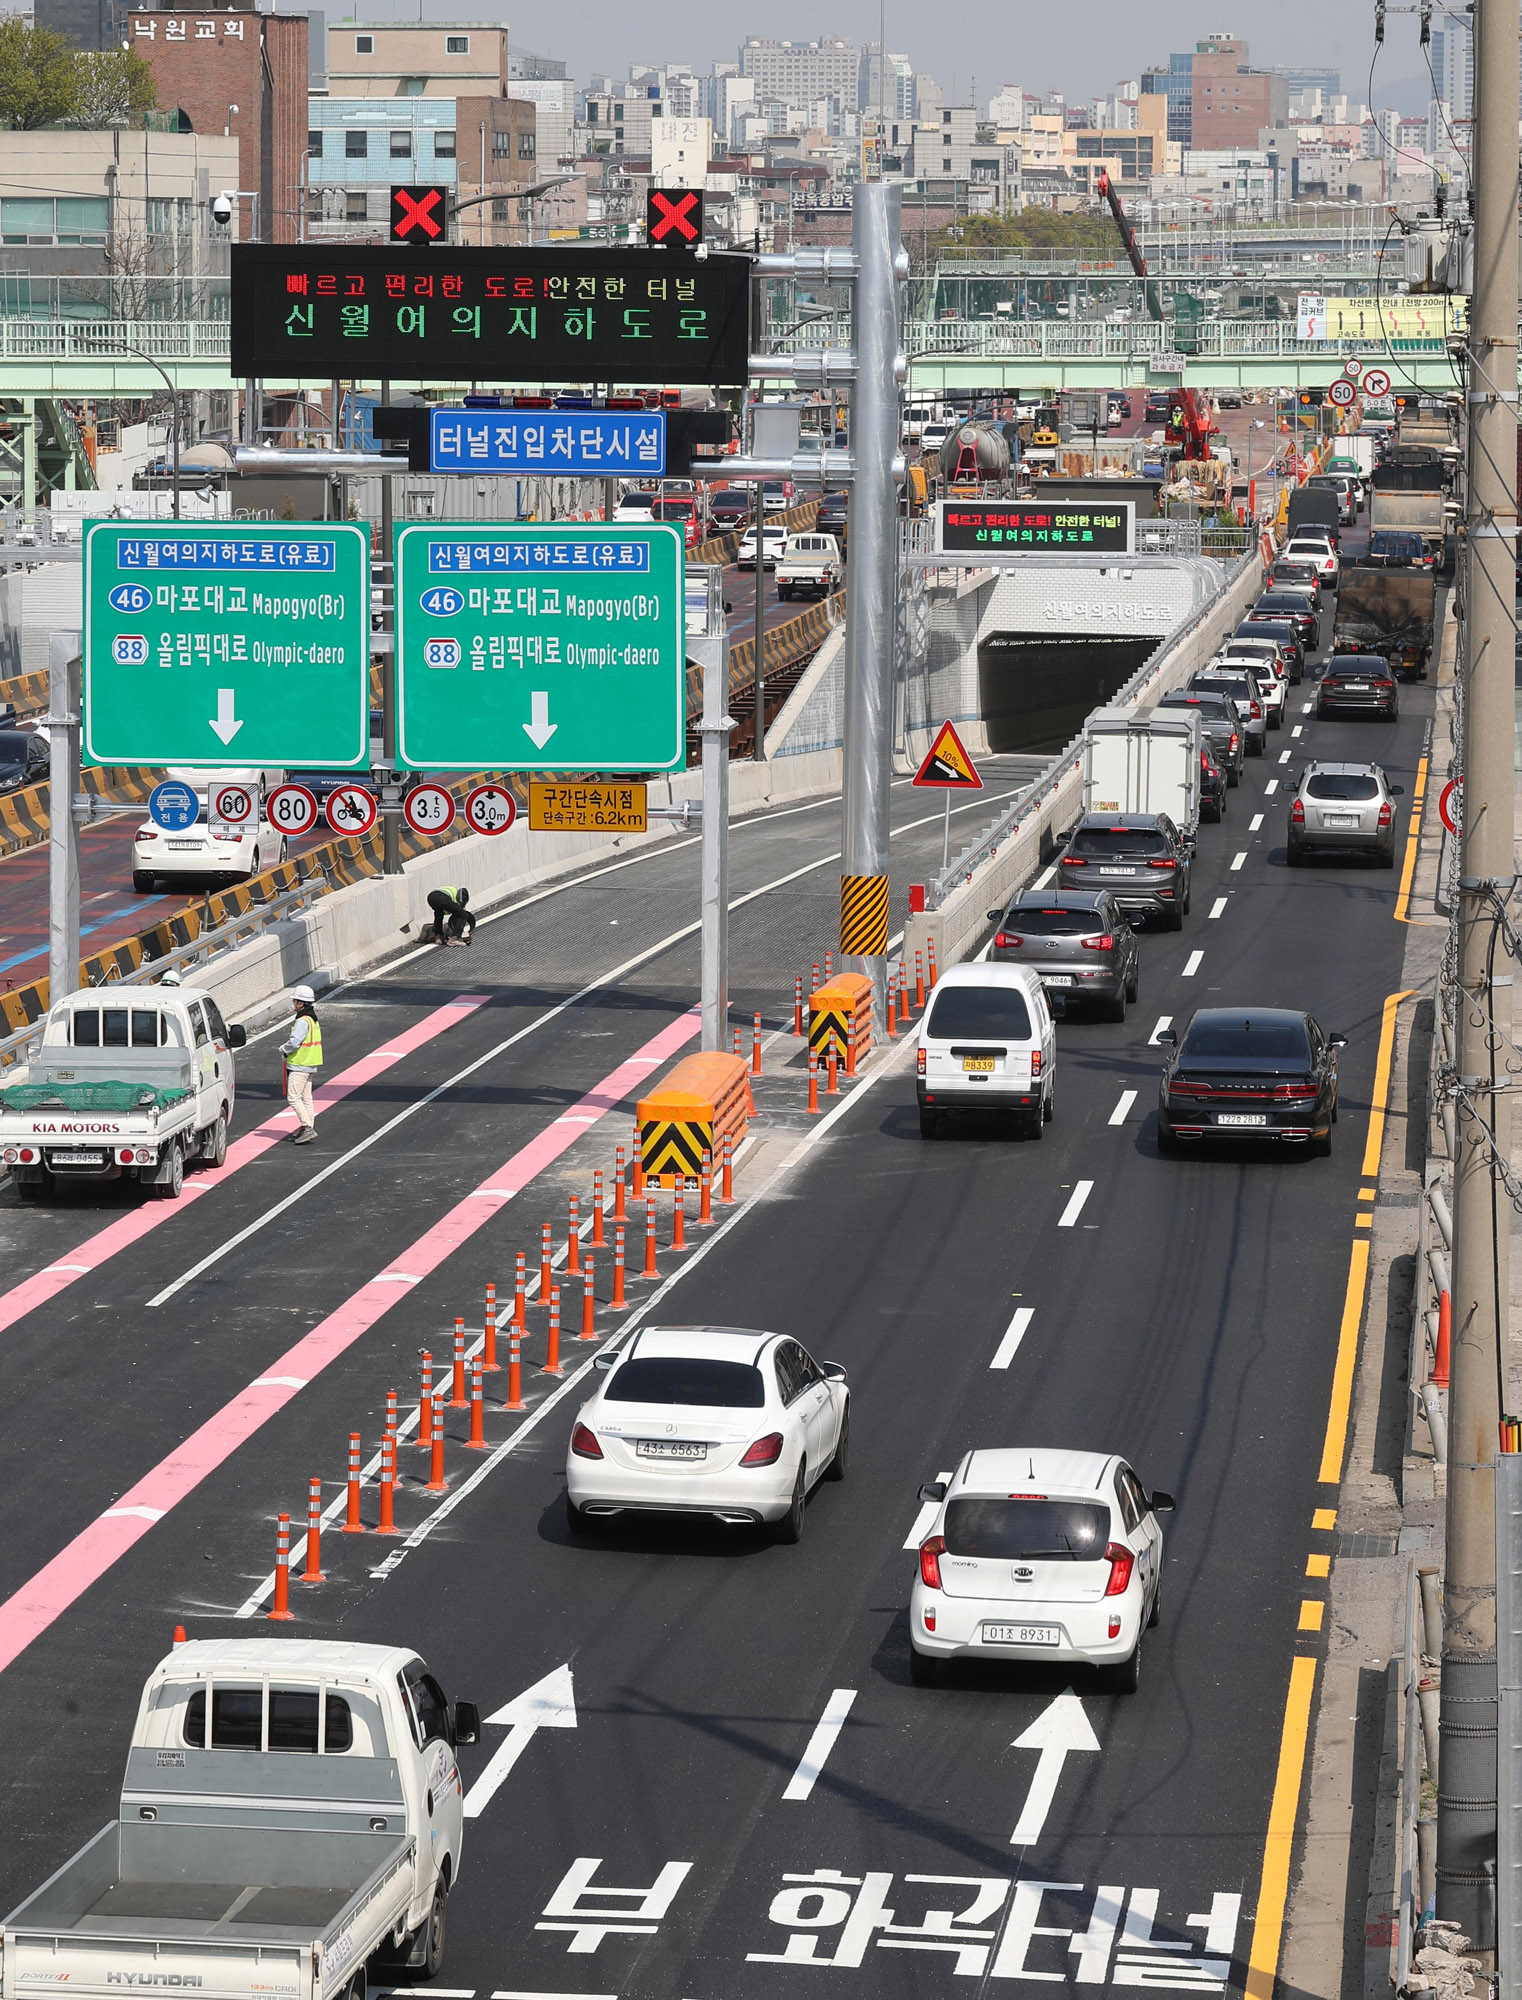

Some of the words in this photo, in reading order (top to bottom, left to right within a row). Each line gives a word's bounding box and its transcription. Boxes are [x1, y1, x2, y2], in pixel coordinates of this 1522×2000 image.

[134, 19, 244, 41] 낙원교회
[285, 273, 367, 297] 빠르고
[384, 274, 465, 299] 편리한
[548, 275, 628, 301] 안전한
[646, 277, 696, 302] 터널
[1383, 298, 1398, 308] 안내
[1348, 364, 1359, 373] 50
[1334, 386, 1351, 399] 50
[439, 424, 659, 462] 터널진입차단시설
[1054, 514, 1091, 528] 안전한
[1092, 514, 1121, 529] 터널!
[123, 542, 330, 567] 신월여의지하도로(유료)
[435, 545, 644, 570] 신월여의지하도로(유료)
[116, 588, 144, 609] 46
[156, 584, 249, 615] 마포대교
[252, 592, 346, 621] Mapogyo(Br)
[427, 591, 457, 613] 46
[468, 586, 562, 617] 마포대교
[566, 594, 661, 622] Mapogyo(Br)
[1042, 600, 1173, 621] 신월여의지하도로
[117, 640, 143, 660] 88
[156, 632, 249, 669] 올림픽대로
[252, 640, 345, 668] Olympic-daero
[429, 643, 455, 664] 88
[469, 635, 562, 672] 올림픽대로
[566, 642, 660, 670] Olympic-daero
[942, 750, 959, 768] 10%
[222, 794, 246, 815] 60
[278, 798, 306, 821] 80
[543, 788, 633, 810] 구간단속시점
[543, 811, 587, 825] 단속구간
[32, 1123, 56, 1133] KIA
[60, 1123, 120, 1133] MOTORS
[77, 1154, 99, 1163] 0455
[643, 1443, 665, 1454] 43소
[670, 1443, 700, 1456] 6563
[990, 1627, 1014, 1639] 01조
[1020, 1628, 1051, 1641] 8931
[533, 1857, 695, 1954] 부
[745, 1868, 1242, 1991] 화곡터널
[106, 1971, 203, 1988] HYUNDAI
